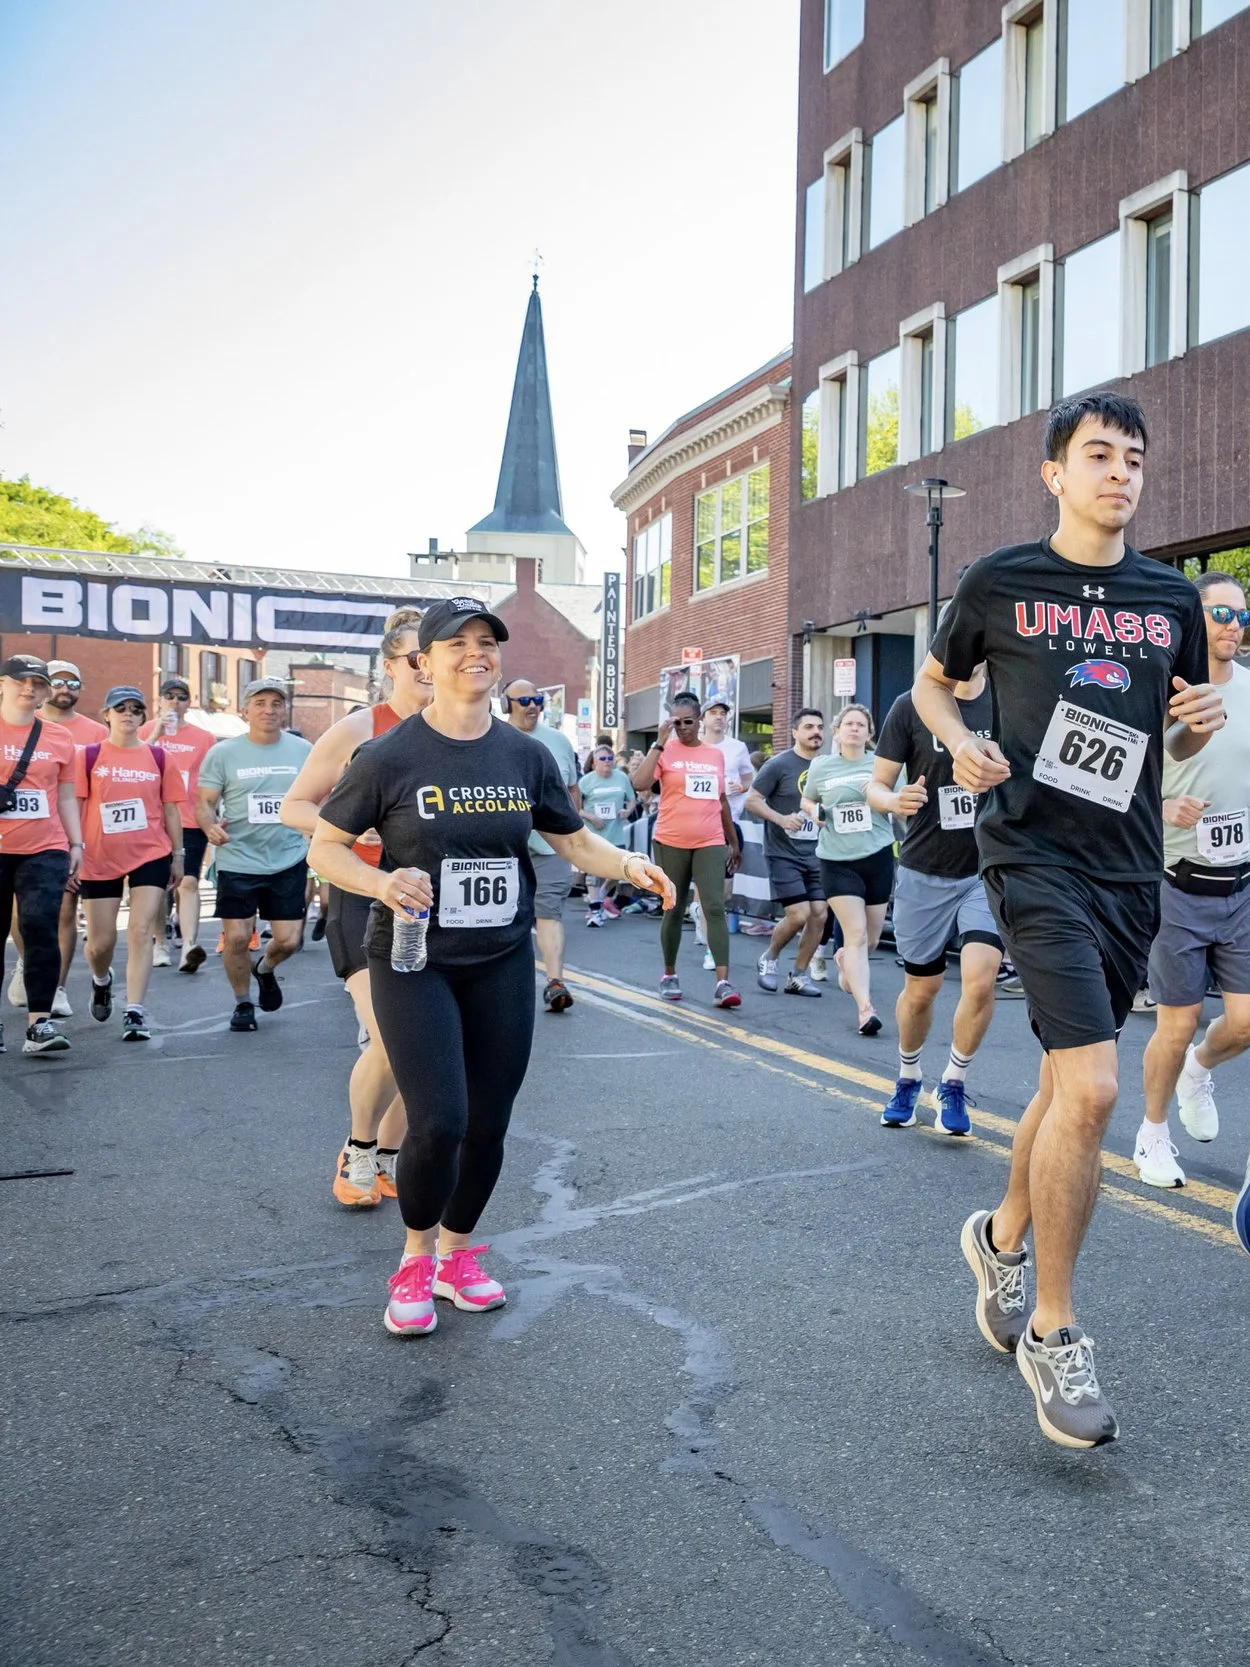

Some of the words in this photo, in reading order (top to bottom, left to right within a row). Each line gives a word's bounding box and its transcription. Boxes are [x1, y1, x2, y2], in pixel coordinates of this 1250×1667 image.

[21, 576, 396, 648] BIONIC
[607, 574, 617, 660] PAINTED
[1015, 601, 1171, 648] UMASS
[1049, 639, 1148, 659] LOWELL
[605, 664, 616, 726] BURRO
[1065, 707, 1129, 741] BIONIC
[4, 745, 52, 760] Hager
[1059, 730, 1127, 781] 626
[112, 766, 159, 781] Hanger
[449, 786, 528, 800] CROSSFIT
[693, 781, 712, 792] 212
[944, 786, 967, 794] BION
[1039, 772, 1058, 784] FOOD
[1070, 784, 1091, 796] DRINK
[1102, 796, 1123, 808] DRINK
[112, 808, 135, 823] 277
[258, 801, 281, 814] 169
[840, 809, 863, 823] 786
[1203, 811, 1242, 824] BIONIC
[1211, 823, 1243, 847] 978
[452, 861, 506, 871] BIONIC
[459, 876, 507, 906] 166
